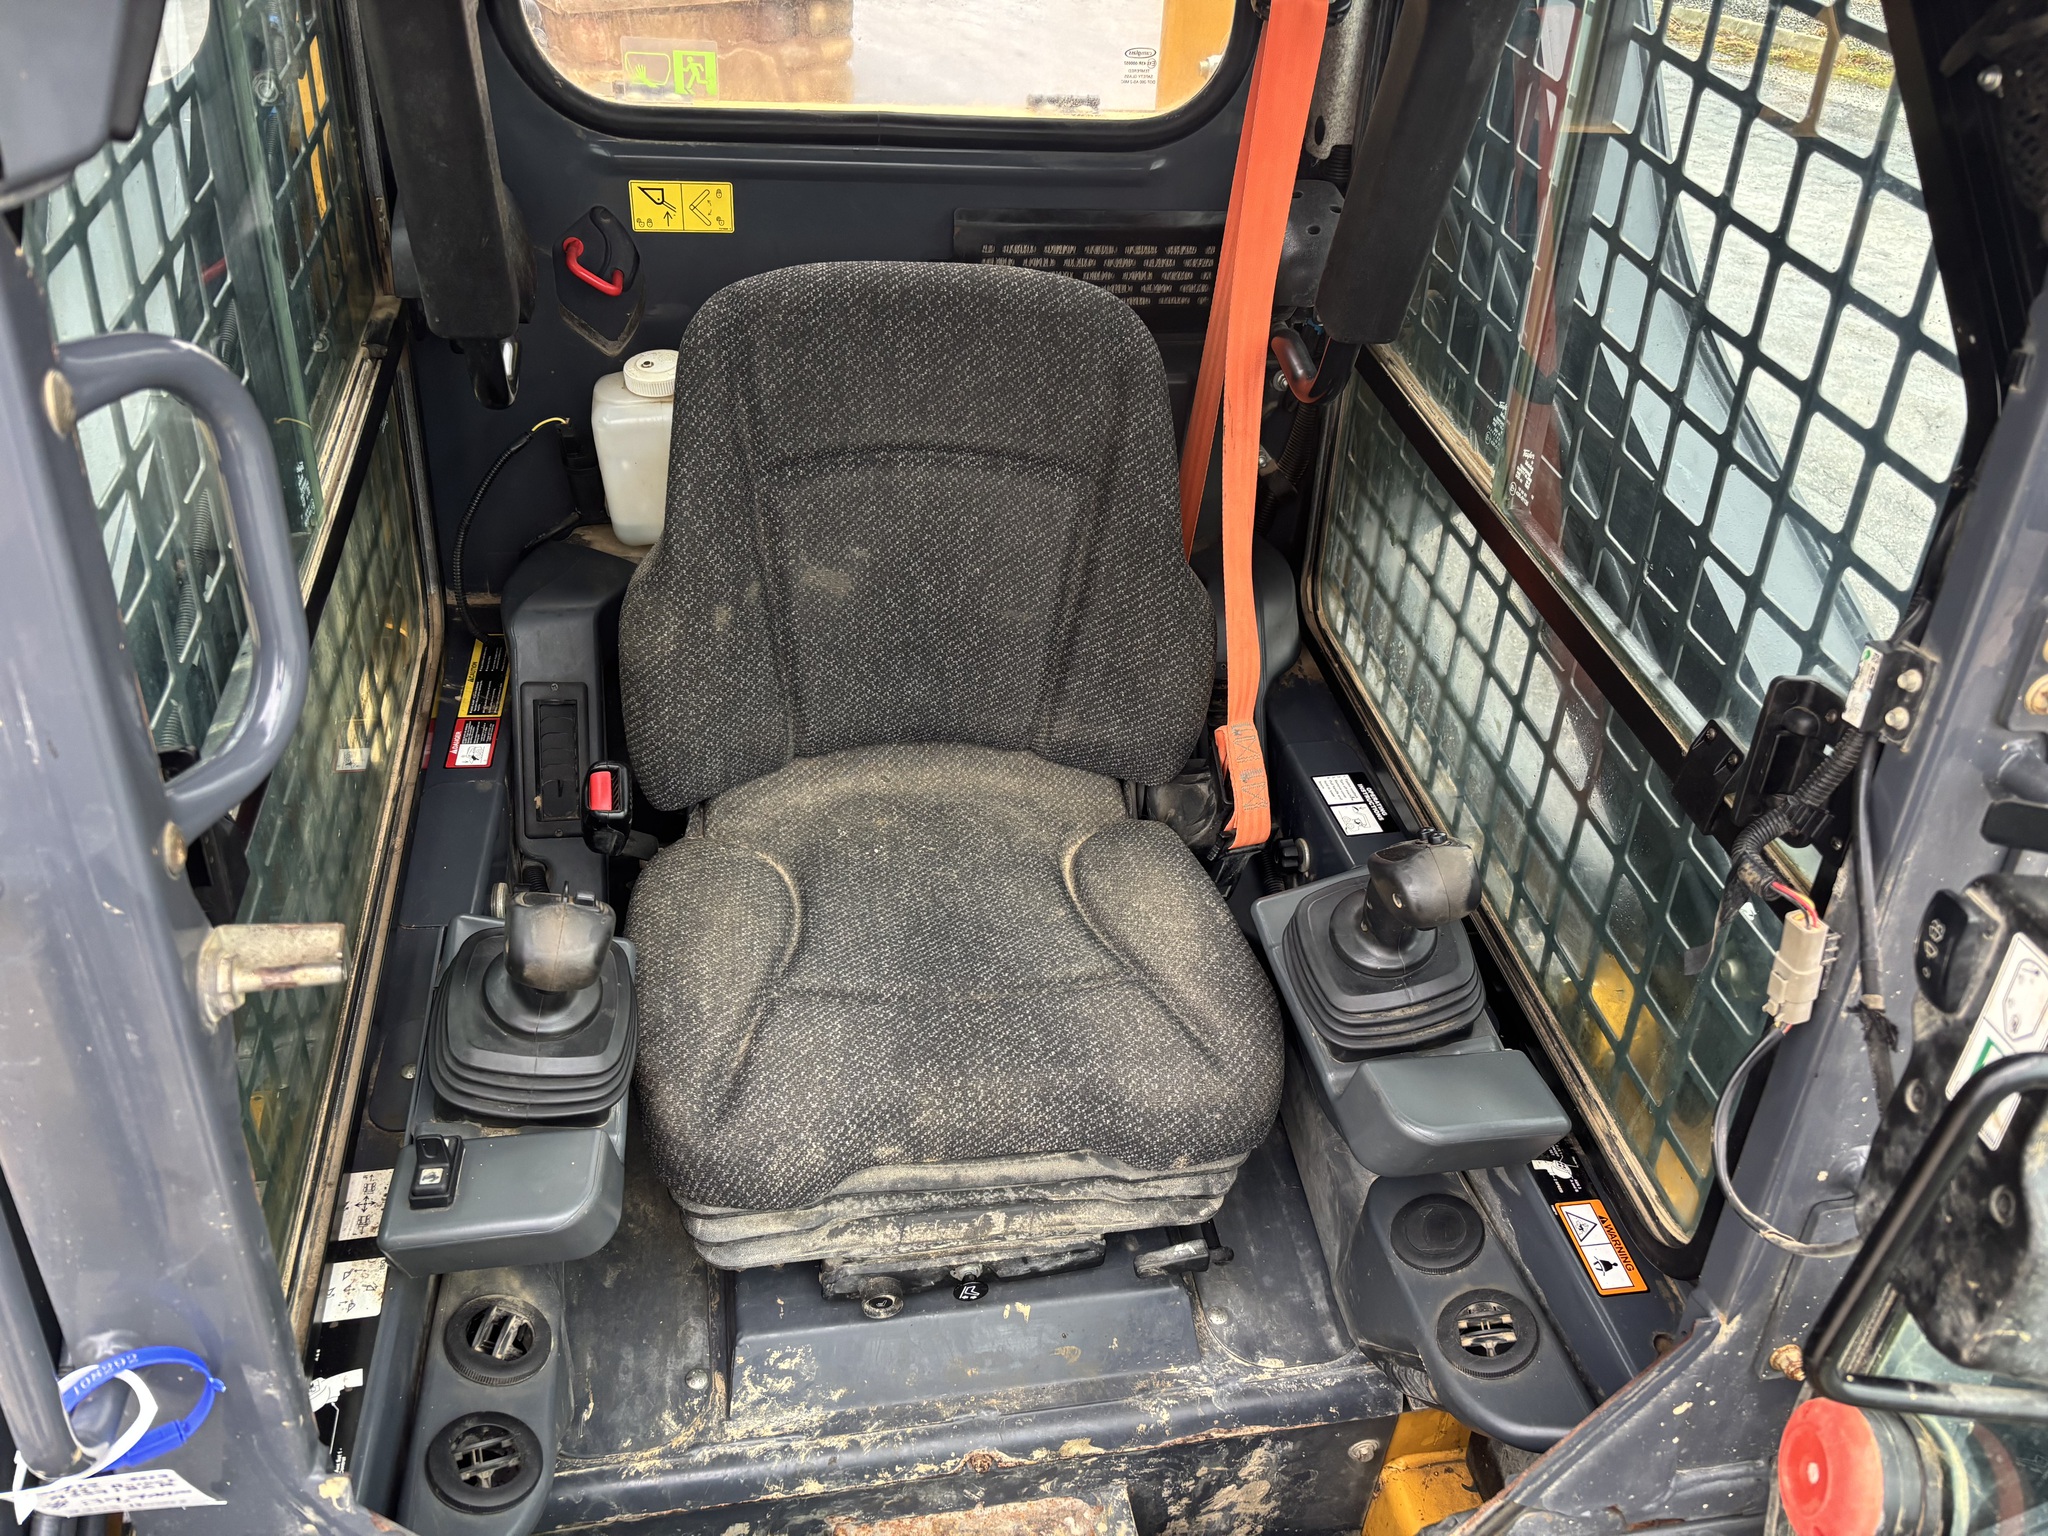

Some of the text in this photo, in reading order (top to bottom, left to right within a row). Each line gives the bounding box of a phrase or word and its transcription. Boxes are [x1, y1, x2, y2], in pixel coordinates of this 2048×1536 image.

[1357, 784, 1384, 821] INSTRUCTIONS
[1366, 787, 1388, 816] OPERATING
[1604, 1223, 1635, 1272] WARNING
